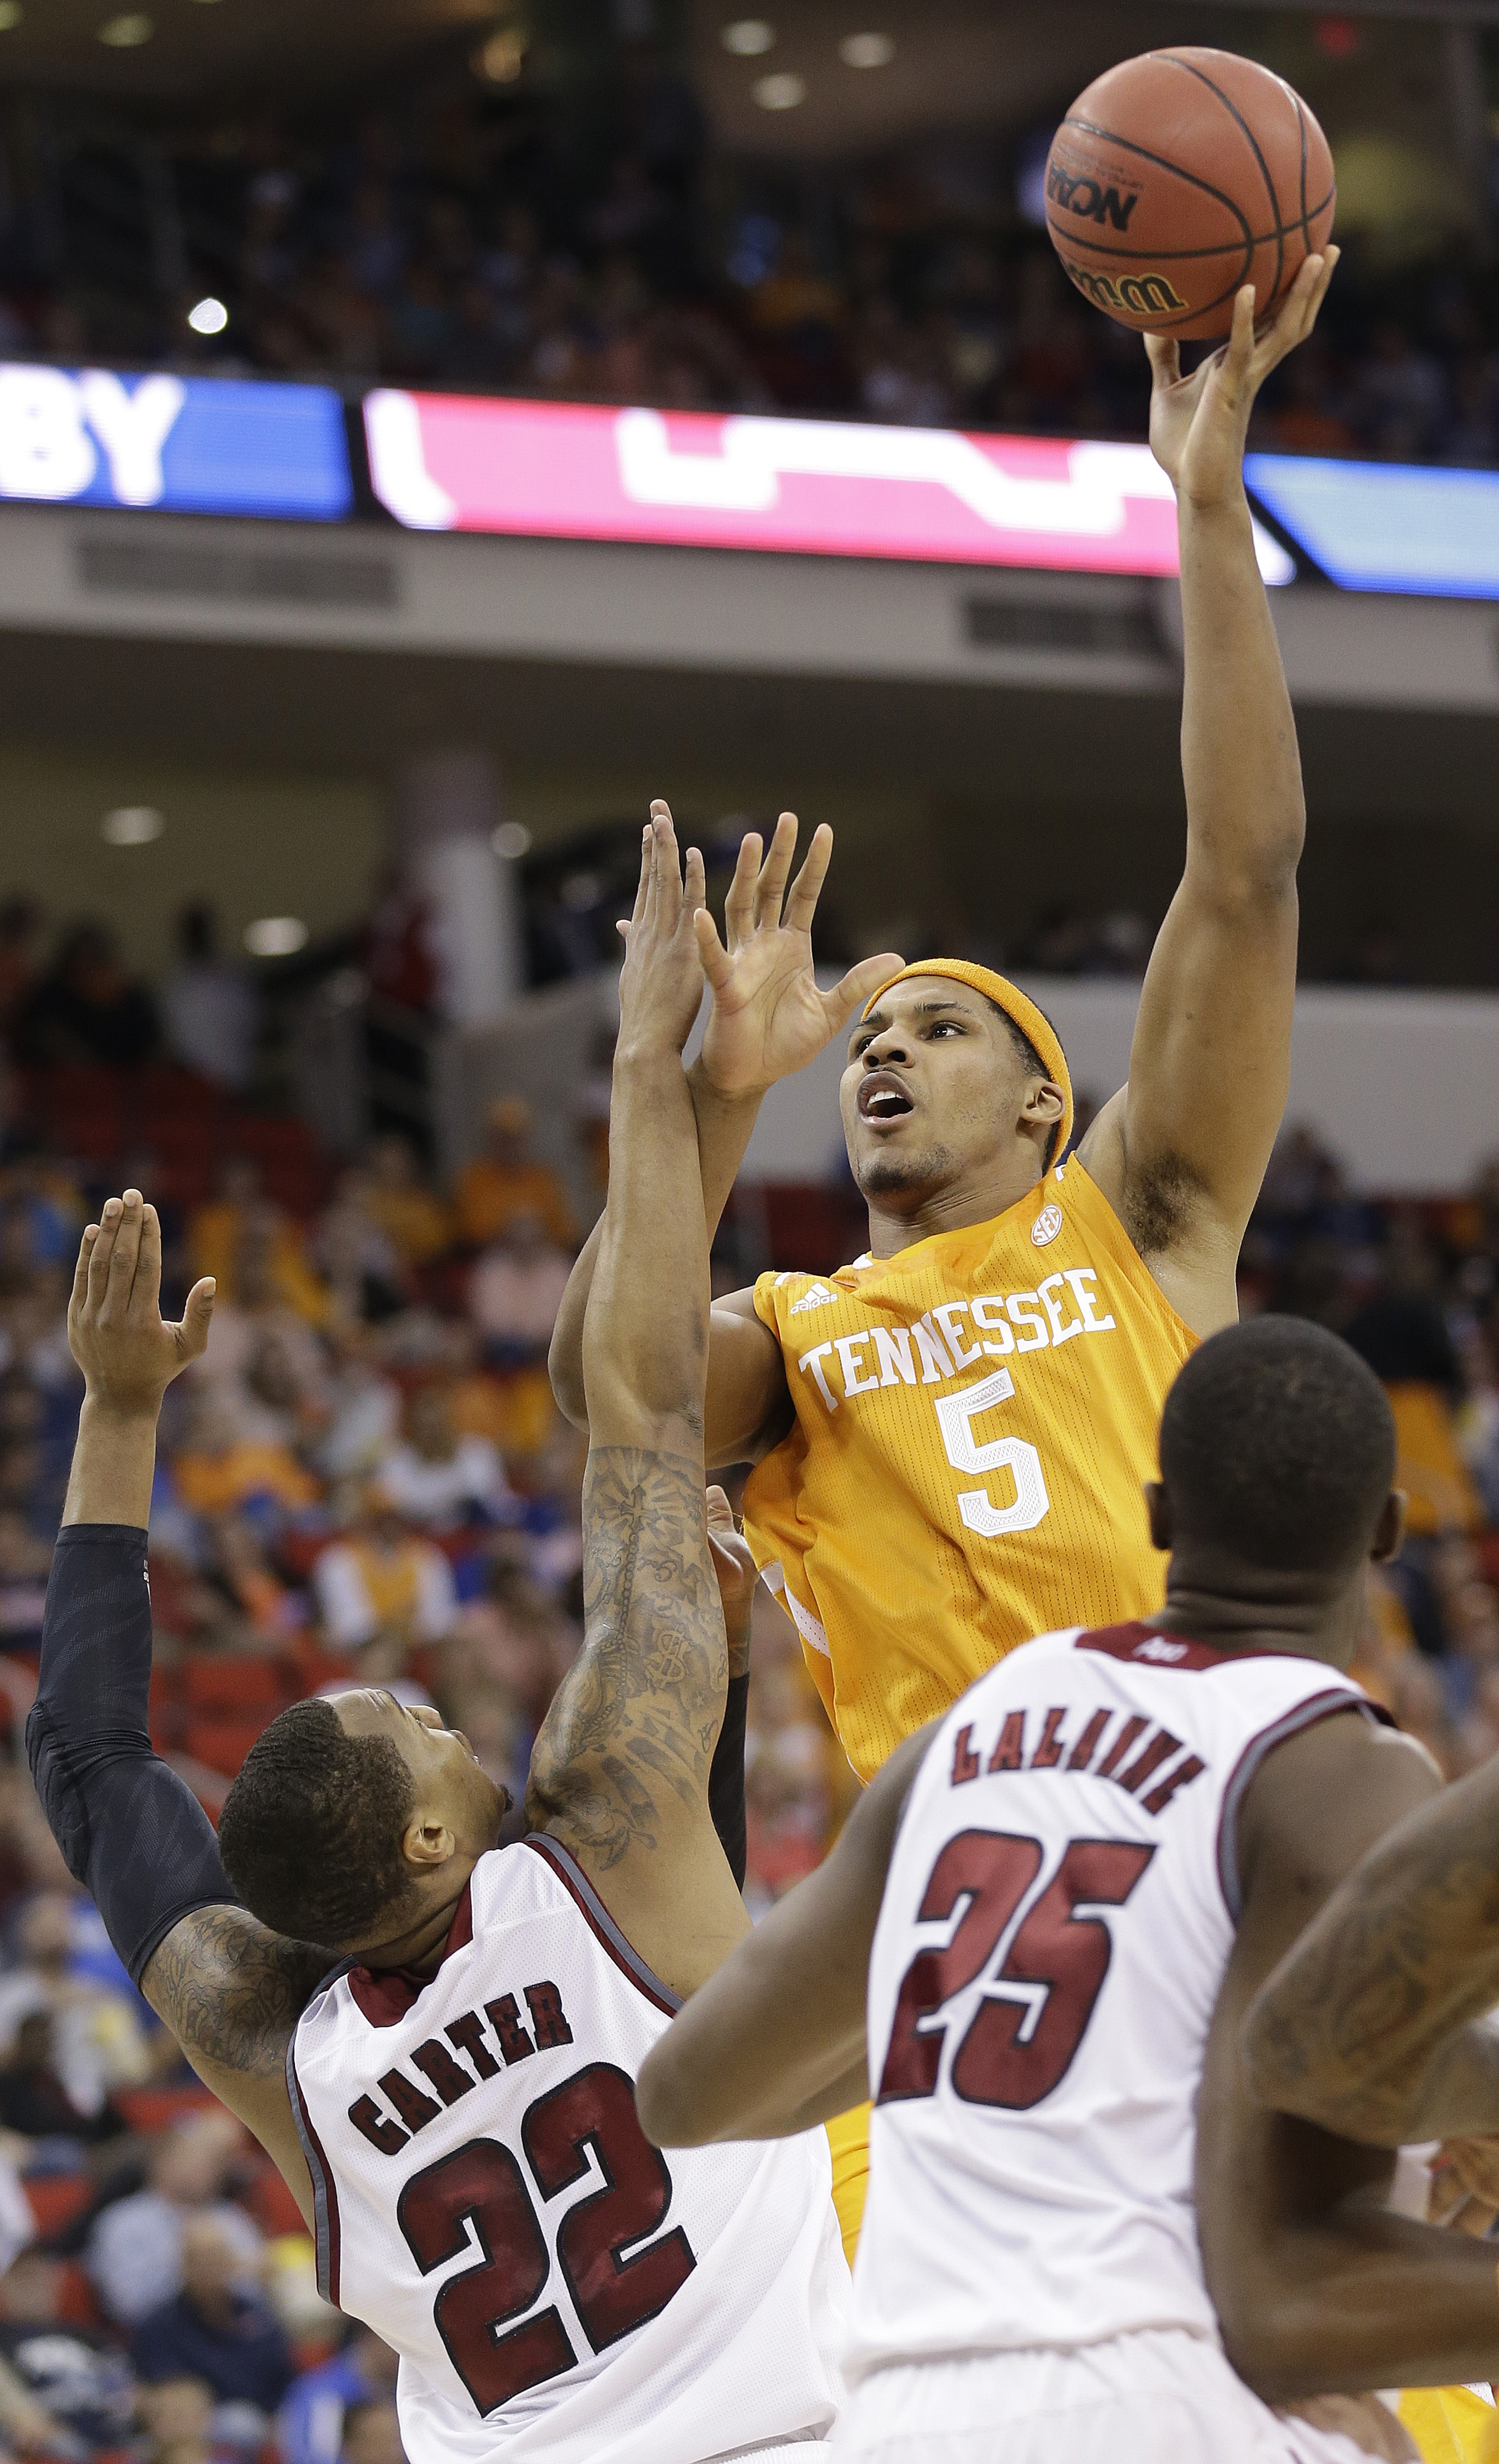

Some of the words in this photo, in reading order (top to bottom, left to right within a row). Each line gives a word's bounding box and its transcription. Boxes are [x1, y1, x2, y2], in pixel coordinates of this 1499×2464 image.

[1047, 158, 1138, 232] NCAA
[789, 1293, 838, 1315] adidas
[1033, 1208, 1060, 1243] SEC
[798, 1268, 1116, 1412] TENNESSEE
[934, 1367, 1049, 1538] 5
[875, 1828, 1157, 2110] 25
[347, 1980, 573, 2156] CARTER
[397, 2062, 697, 2419] 22
